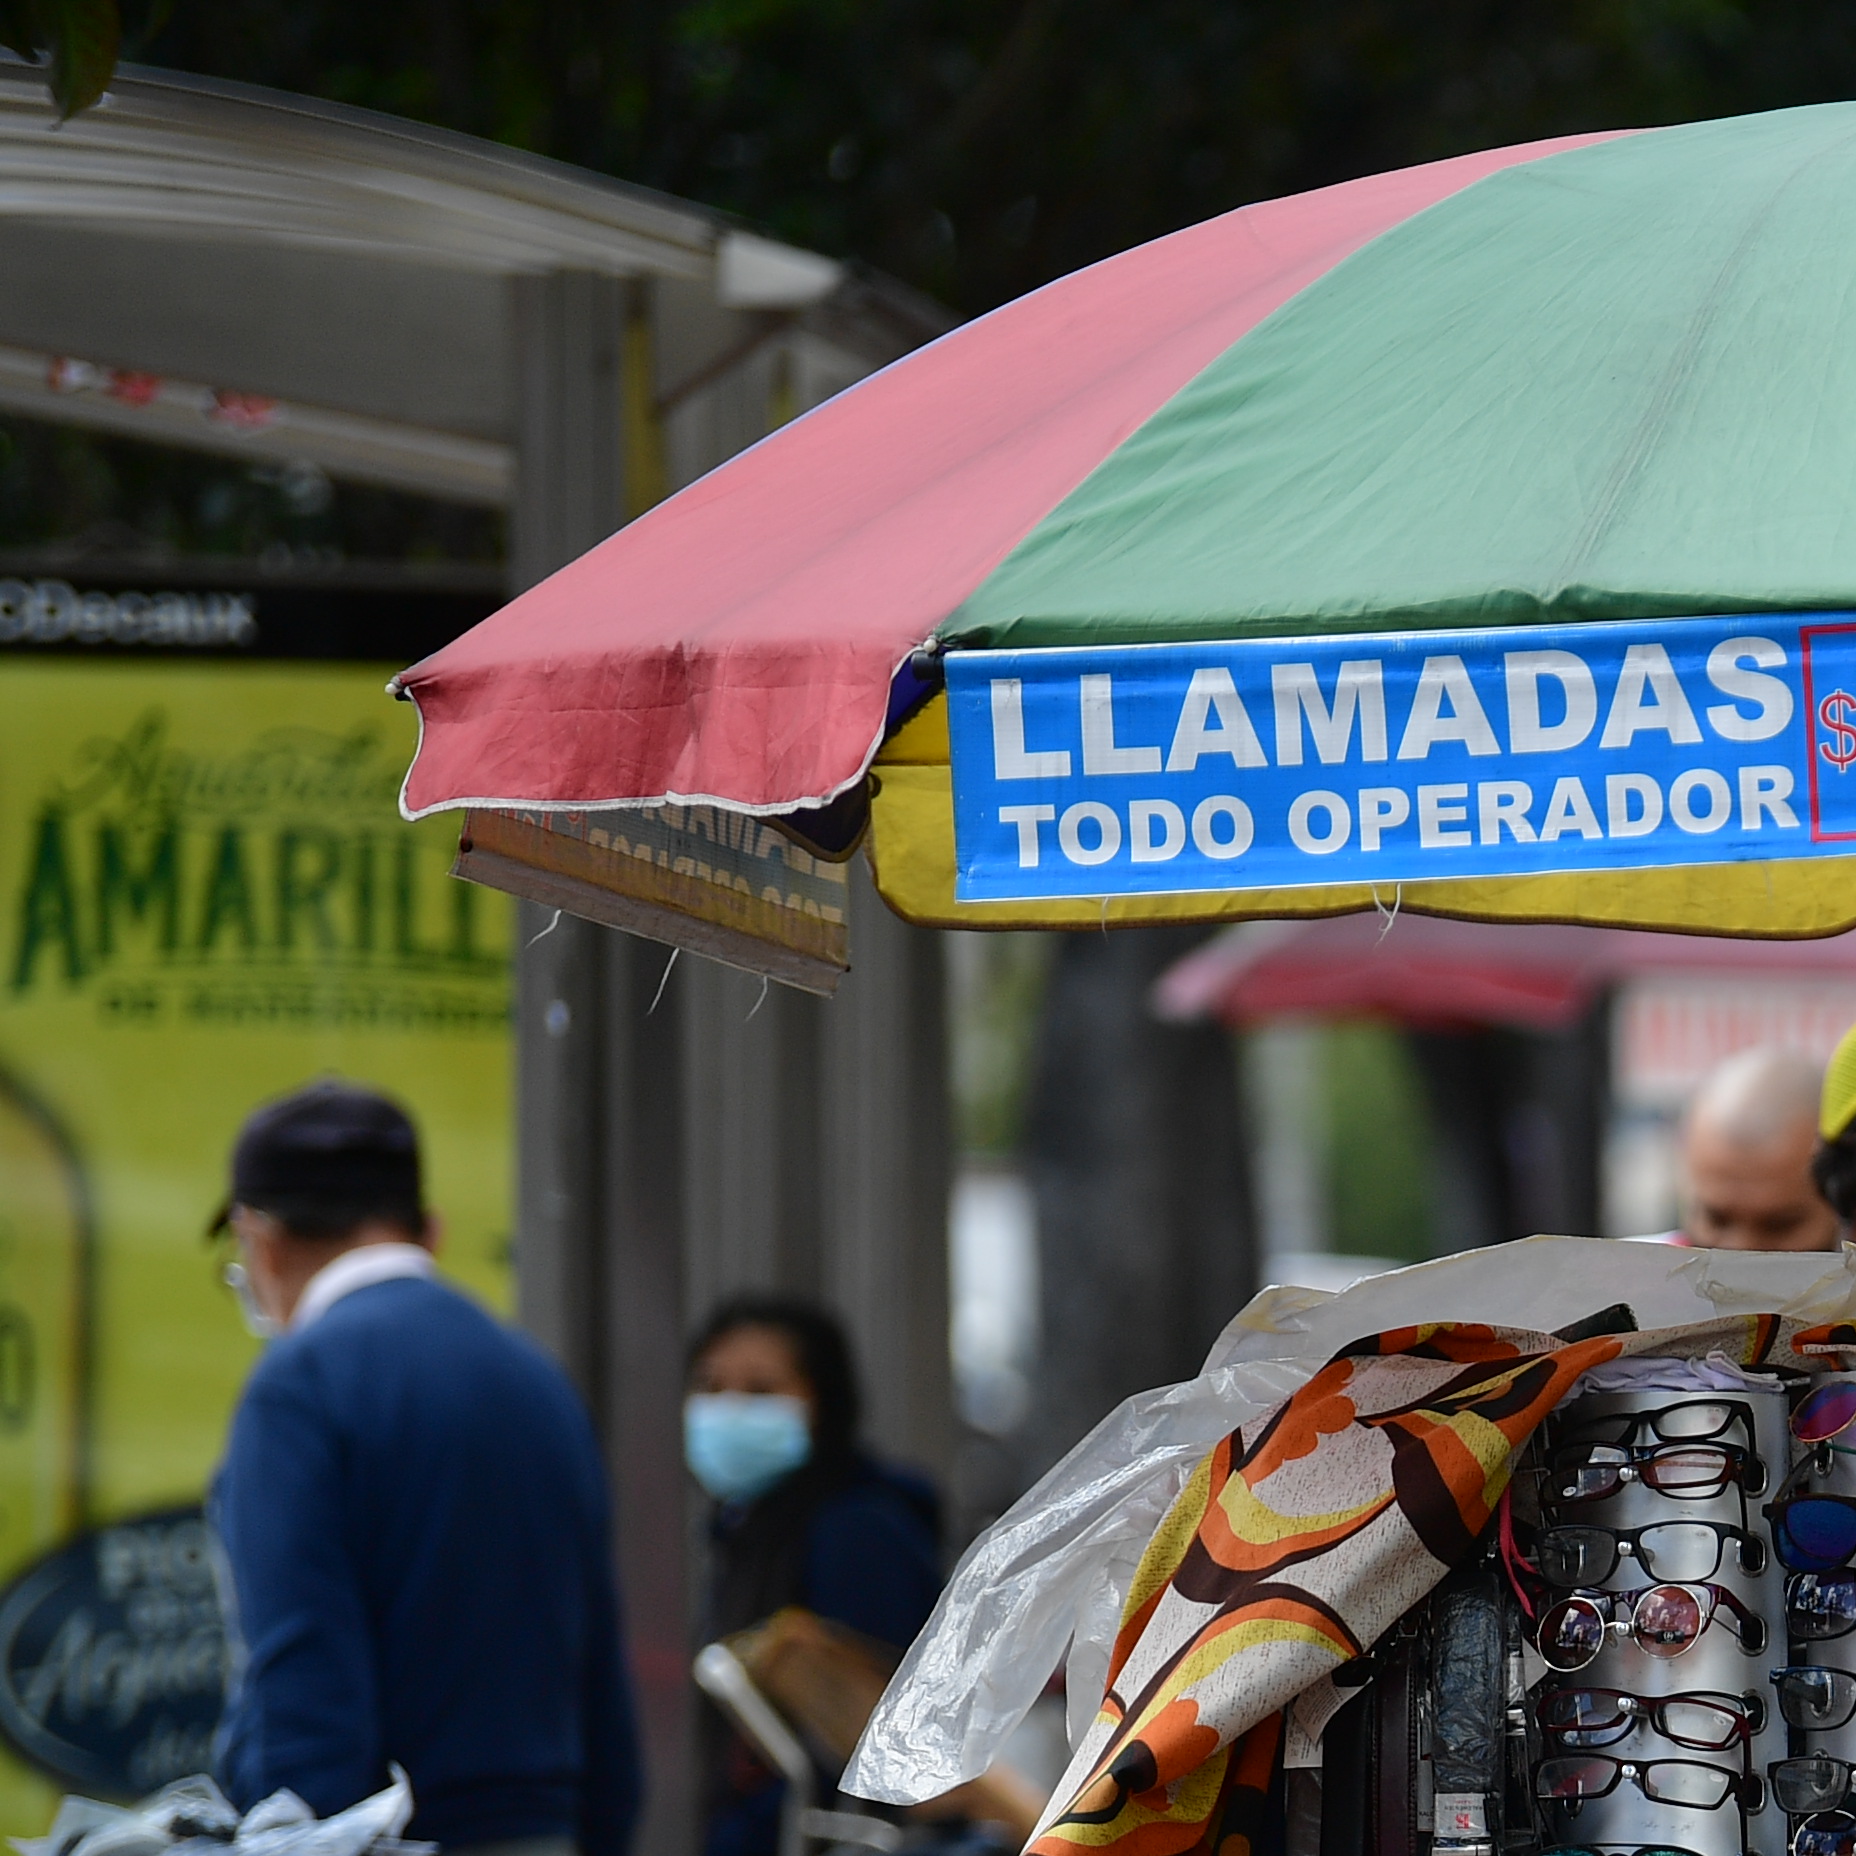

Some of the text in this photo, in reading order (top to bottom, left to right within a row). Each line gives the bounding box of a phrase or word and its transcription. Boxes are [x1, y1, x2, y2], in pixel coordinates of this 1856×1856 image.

[991, 634, 1796, 780] LLAMADAS
[997, 764, 1801, 869] TODO OPERADOR
